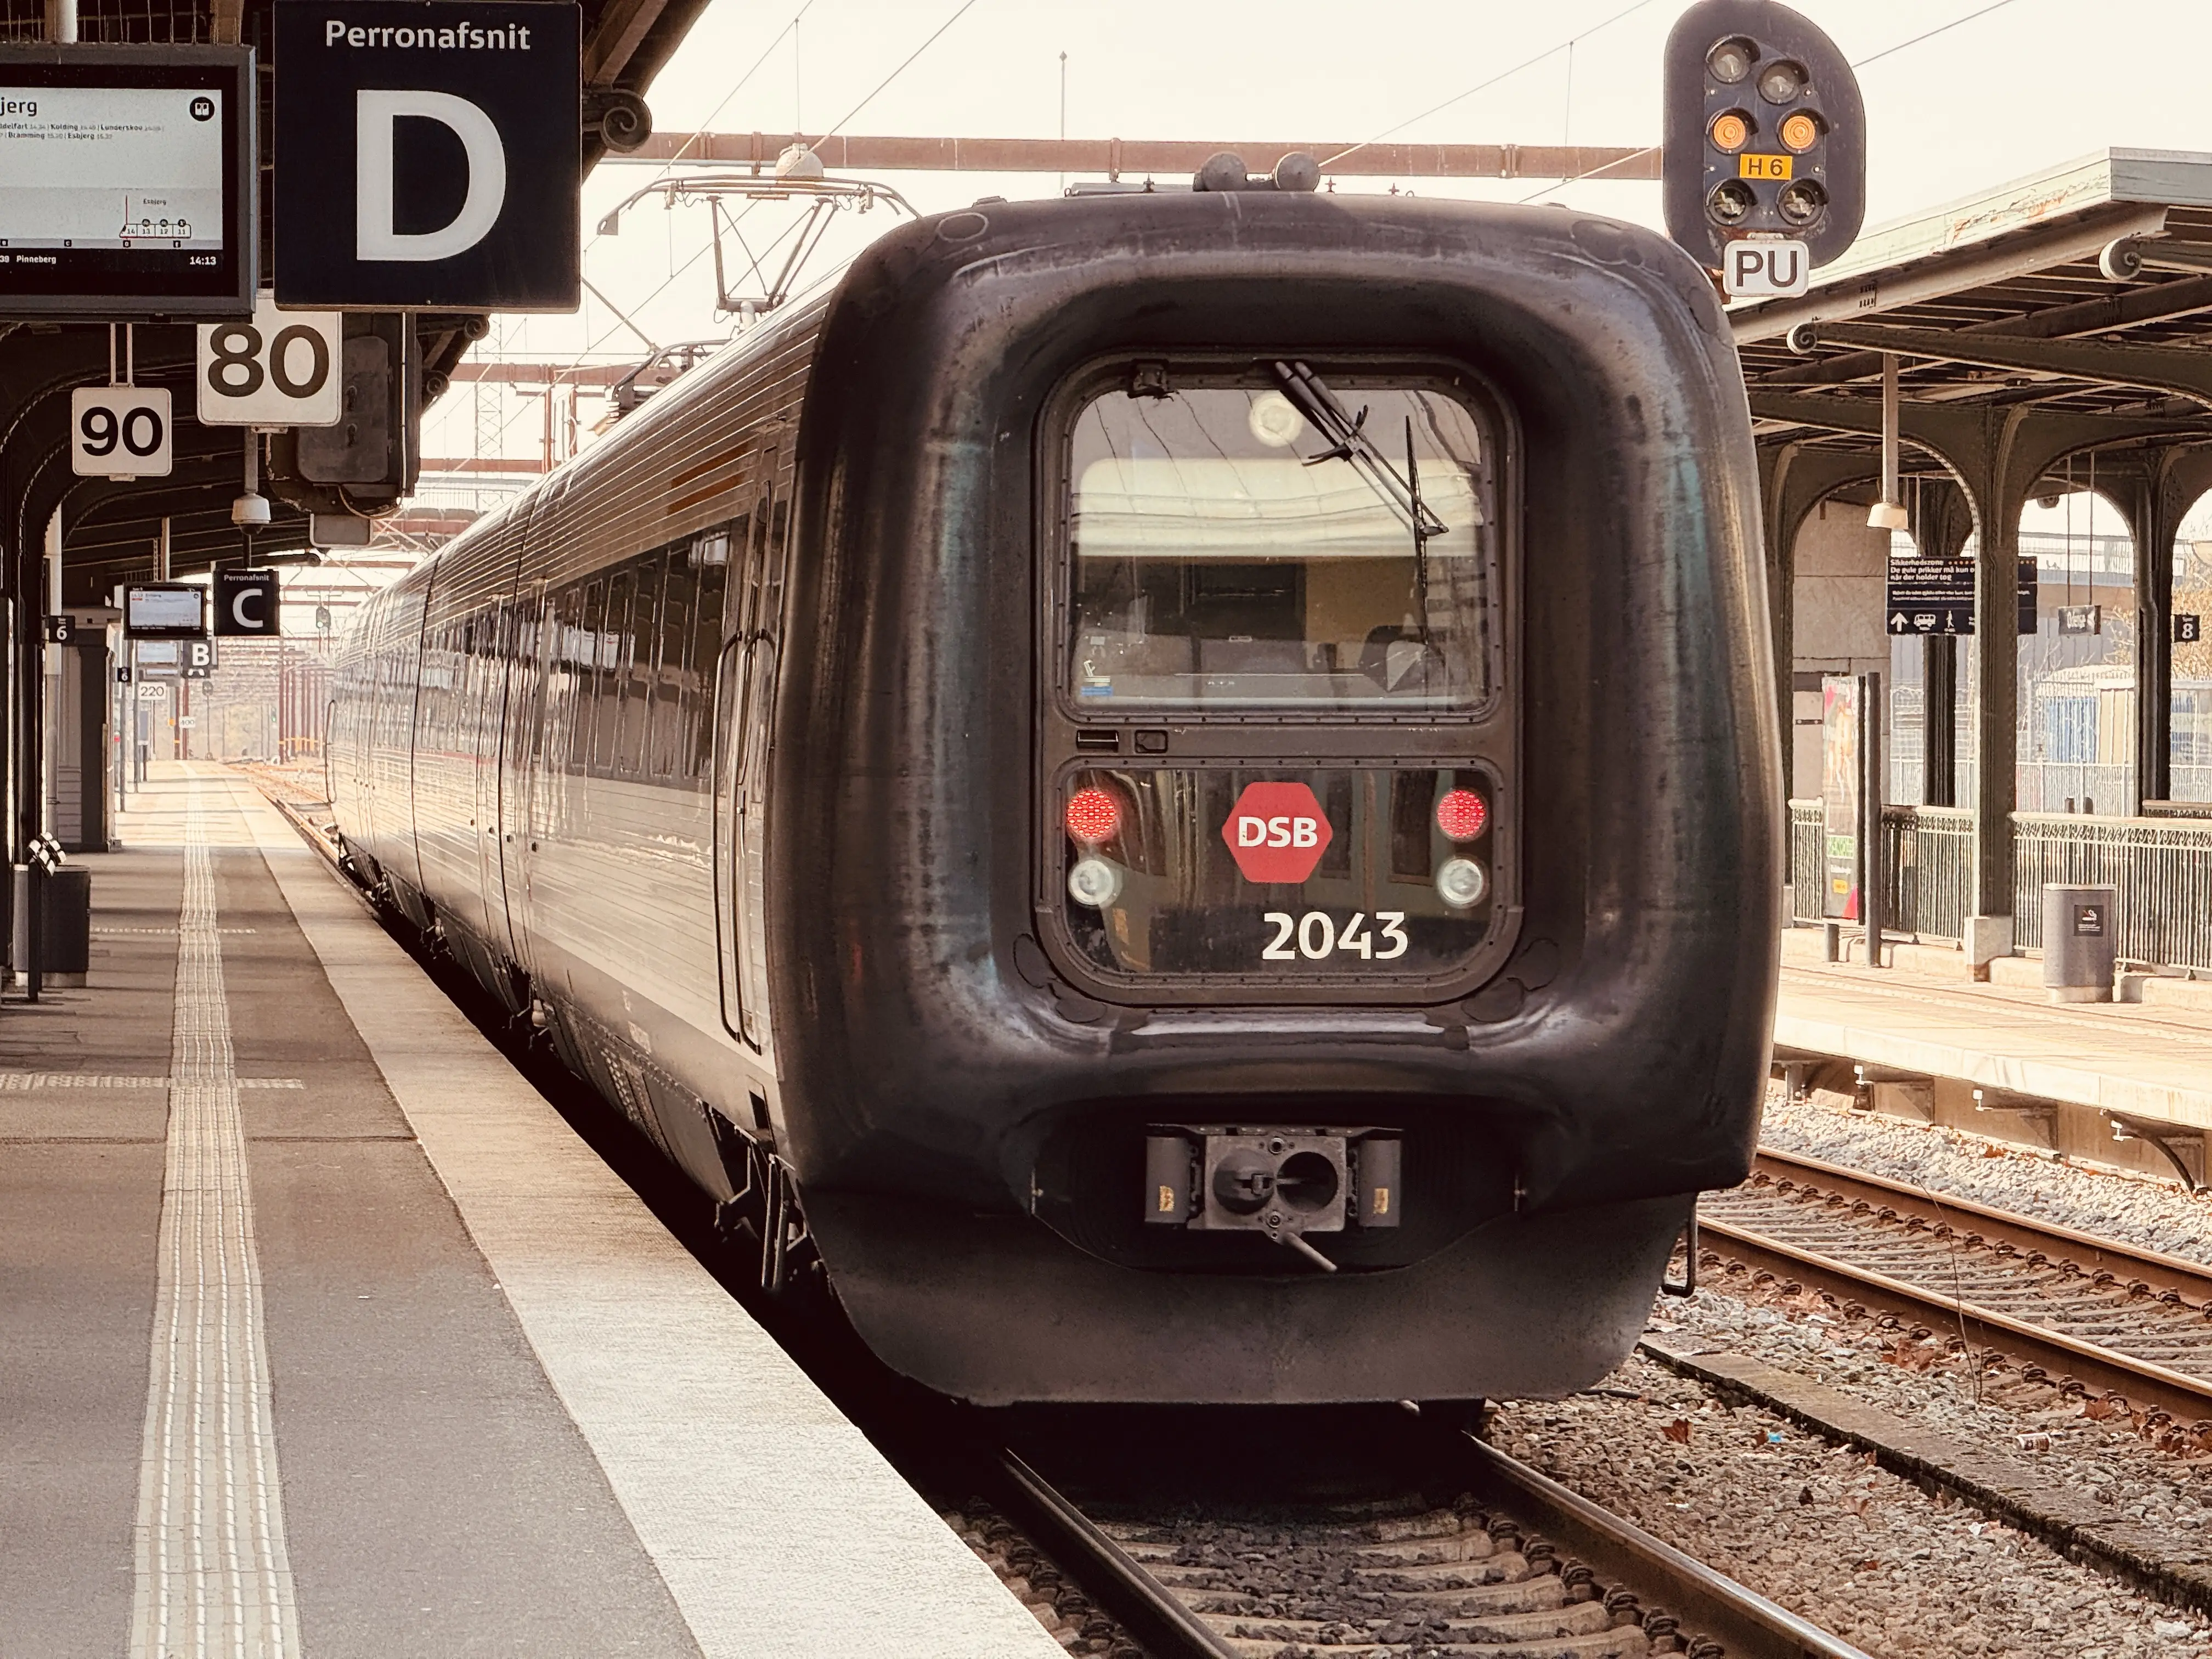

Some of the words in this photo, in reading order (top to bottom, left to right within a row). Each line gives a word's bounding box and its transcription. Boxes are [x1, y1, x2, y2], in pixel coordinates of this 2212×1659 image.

[326, 20, 531, 50] Perronafsnit
[0, 97, 37, 117] jerg
[357, 89, 506, 262] D
[1748, 158, 1762, 175] H
[1770, 159, 1783, 176] 6
[16, 255, 57, 264] Pinneberg
[189, 256, 216, 265] 14:13
[1736, 250, 1798, 287] PU
[207, 323, 329, 399] 80
[81, 407, 163, 456] 90
[233, 589, 263, 628] C
[57, 625, 67, 640] 6
[2182, 623, 2193, 639] 8
[193, 643, 210, 666] B
[121, 673, 128, 681] 6
[140, 686, 164, 697] 220
[1238, 816, 1318, 848] DSB
[1262, 911, 1409, 961] 2043
